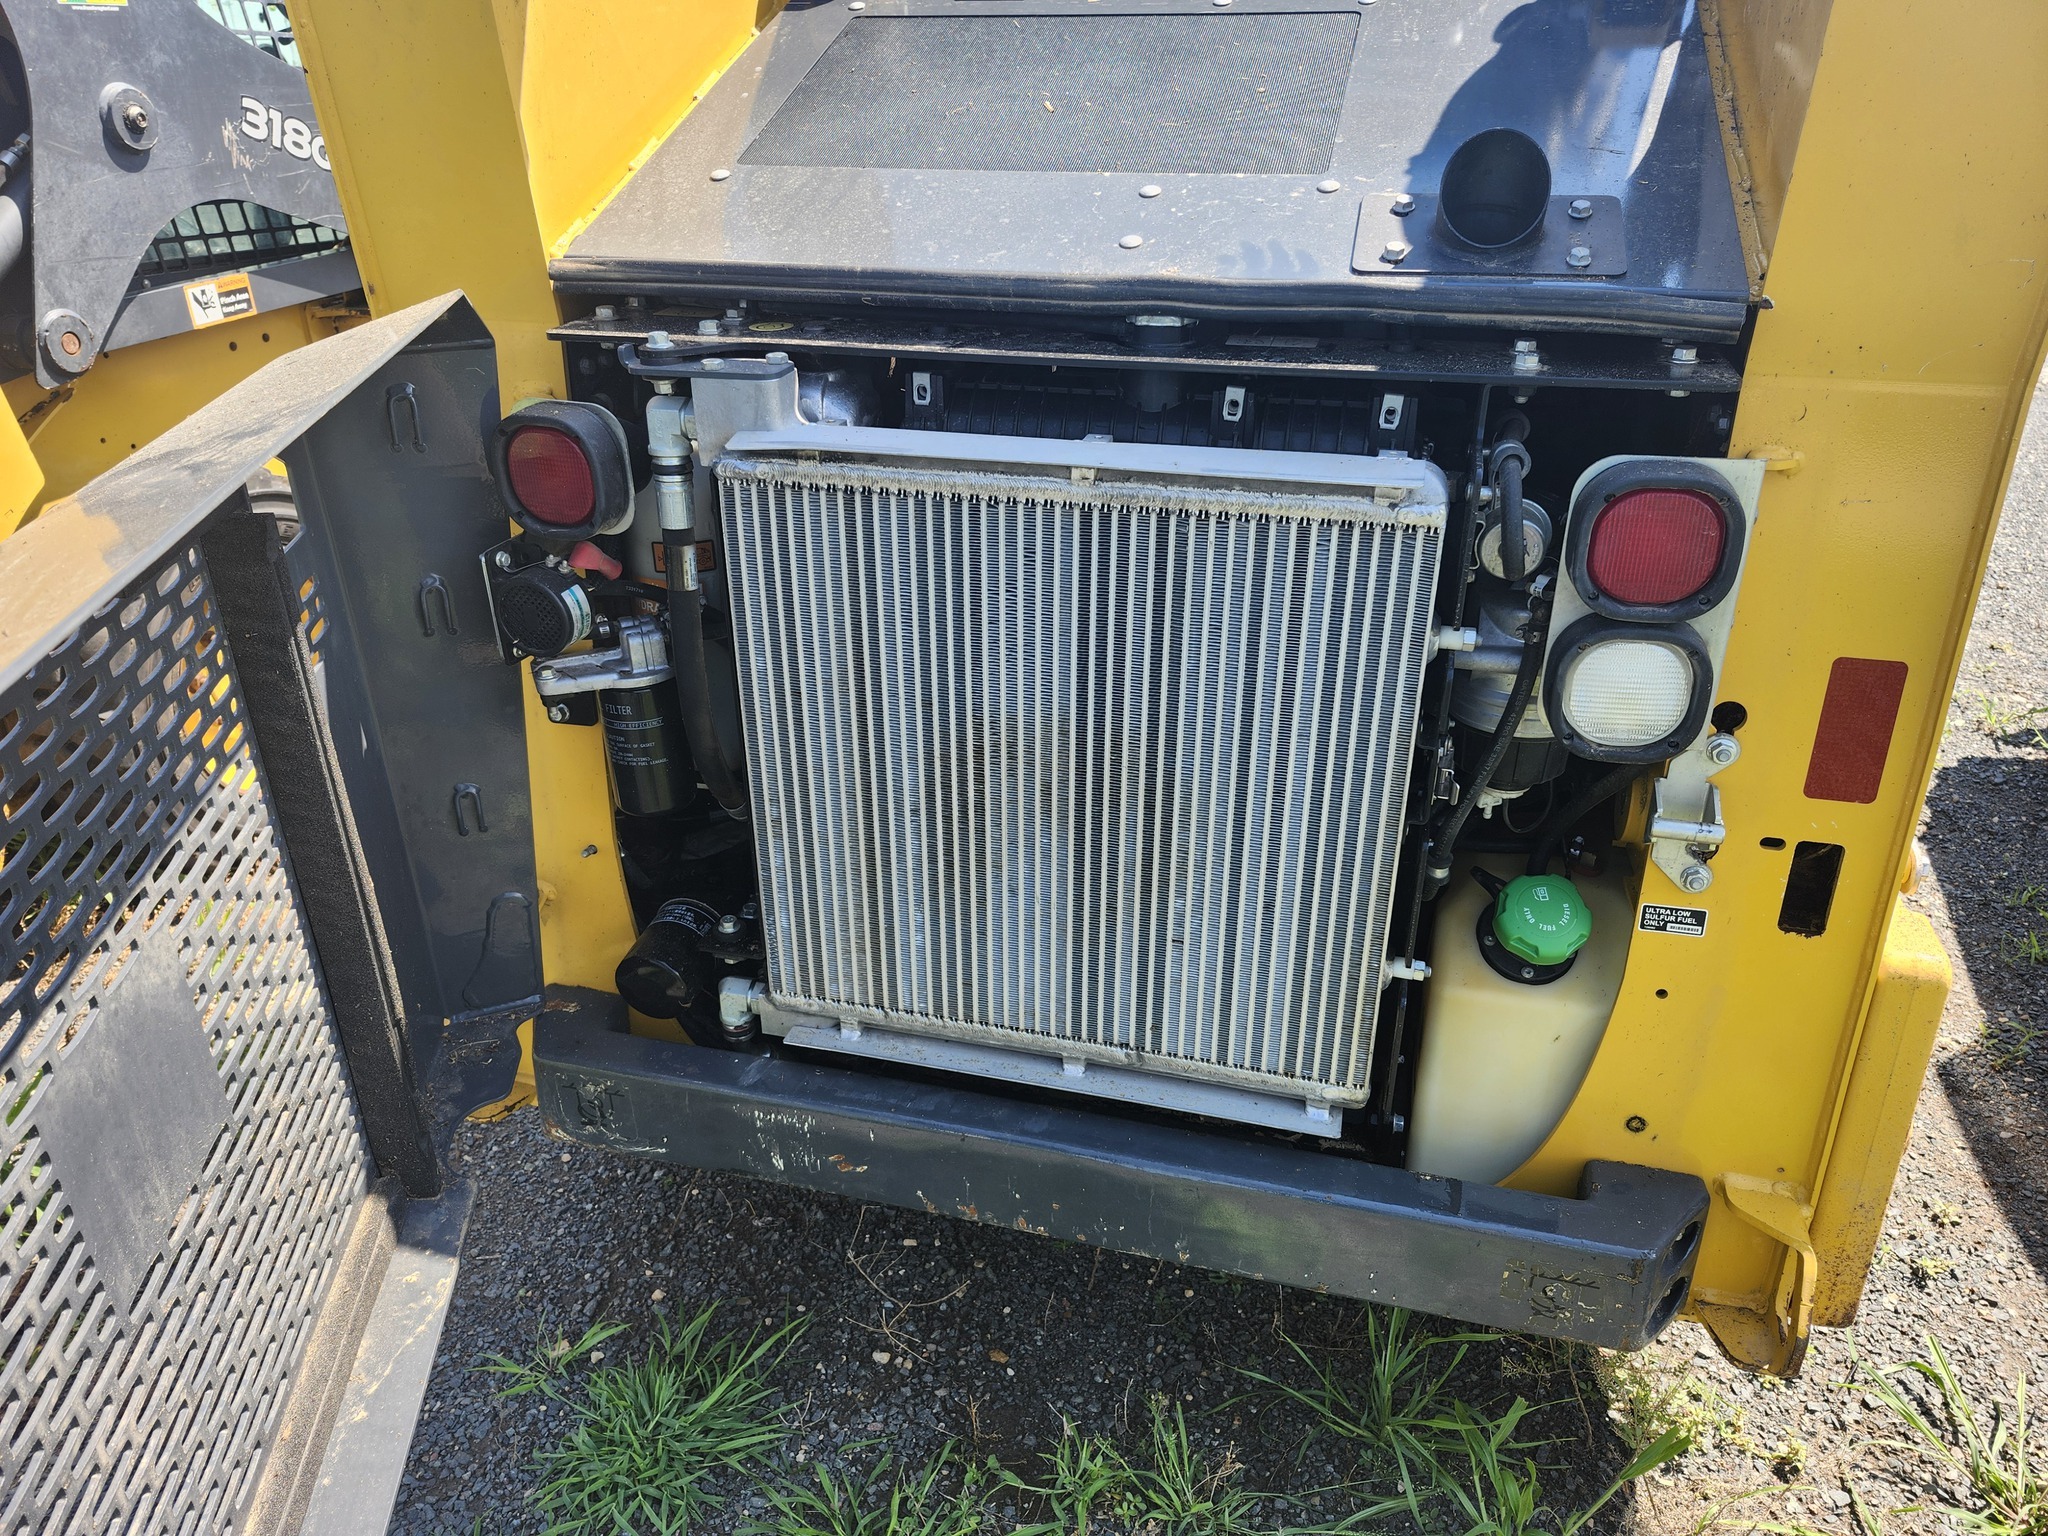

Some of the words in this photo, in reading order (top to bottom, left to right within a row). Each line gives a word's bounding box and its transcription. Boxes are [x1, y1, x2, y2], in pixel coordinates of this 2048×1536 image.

[605, 704, 632, 715] FILTER
[628, 719, 662, 729] EFFICIENCY
[1524, 907, 1536, 924] ONLY
[1559, 903, 1571, 926] DIESEL
[1646, 907, 1671, 915] ULTRA
[1672, 909, 1691, 917] LOW
[1645, 913, 1675, 922] SULFUR
[1677, 917, 1697, 925] FUEL
[1539, 923, 1556, 931] FUEL
